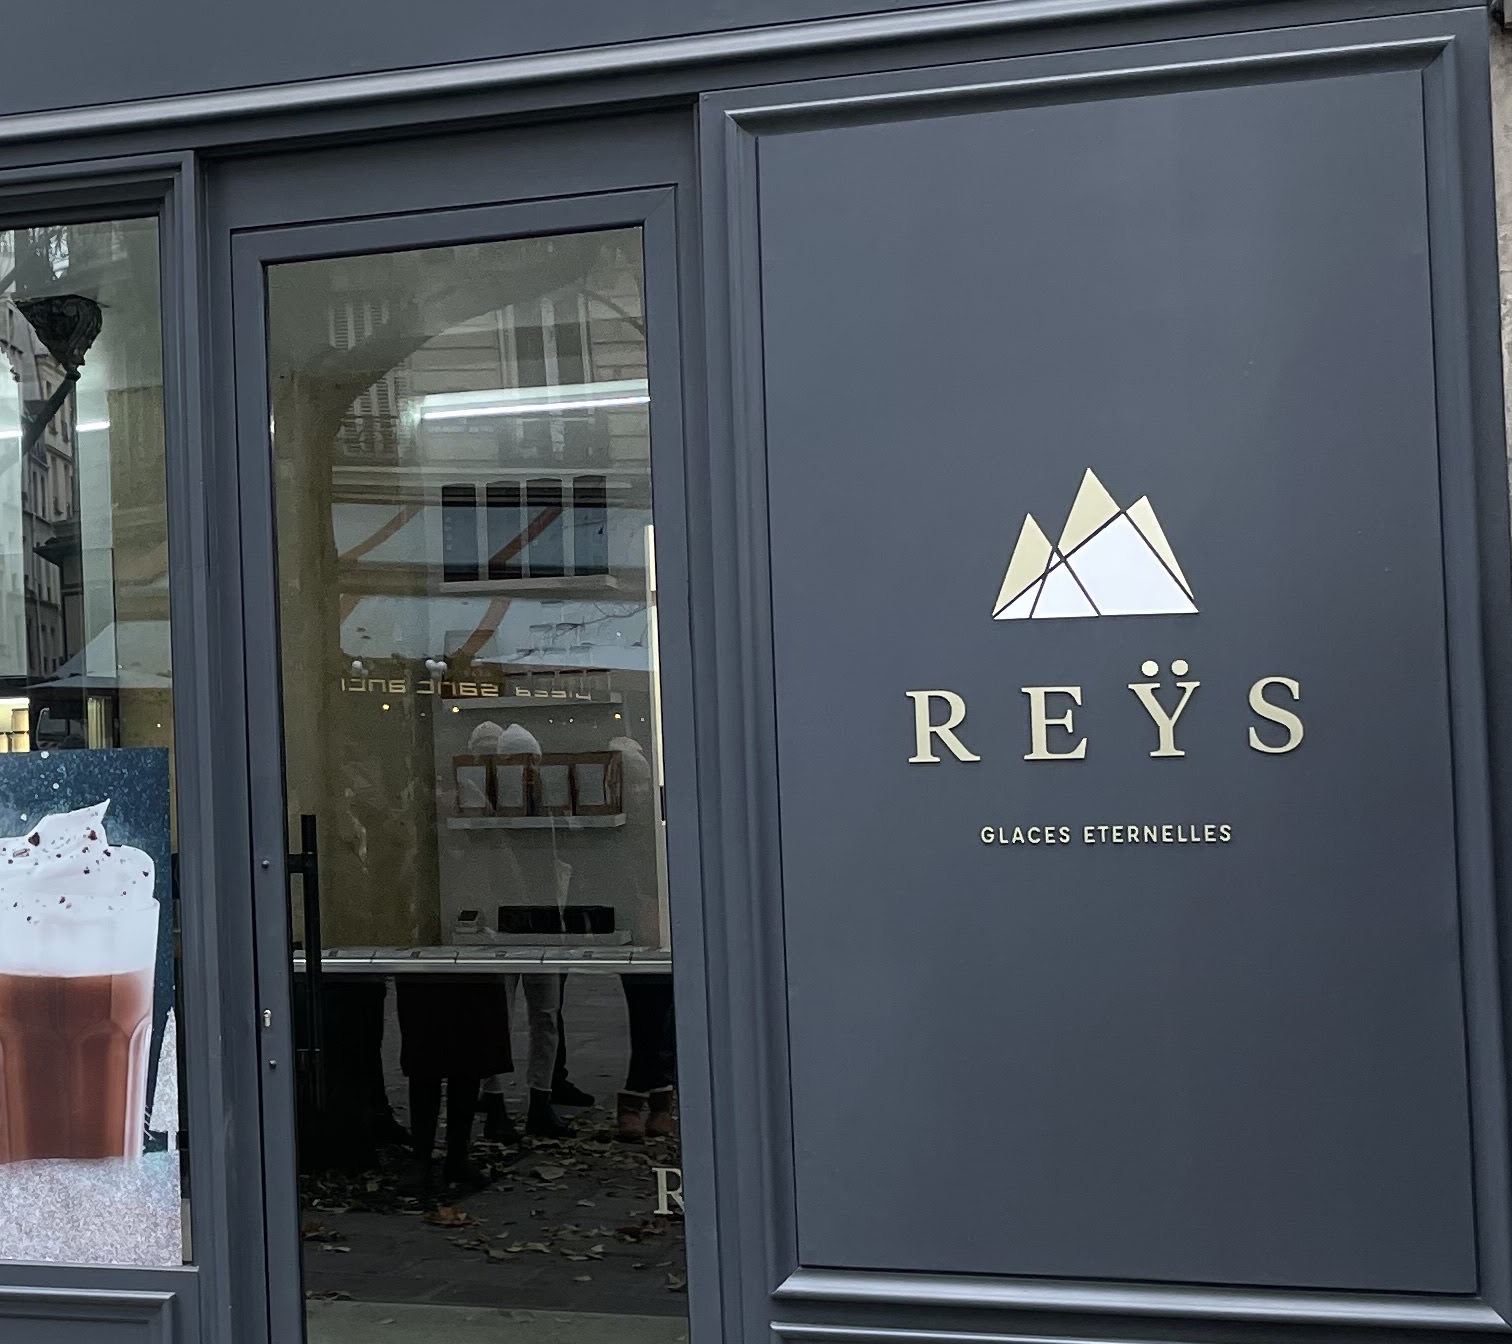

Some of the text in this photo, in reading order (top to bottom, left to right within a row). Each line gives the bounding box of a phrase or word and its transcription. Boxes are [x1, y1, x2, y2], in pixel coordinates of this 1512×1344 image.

[905, 659, 1304, 763] REŸS
[980, 824, 1231, 844] GLACES ETERNELLES
[652, 1167, 685, 1215] R
